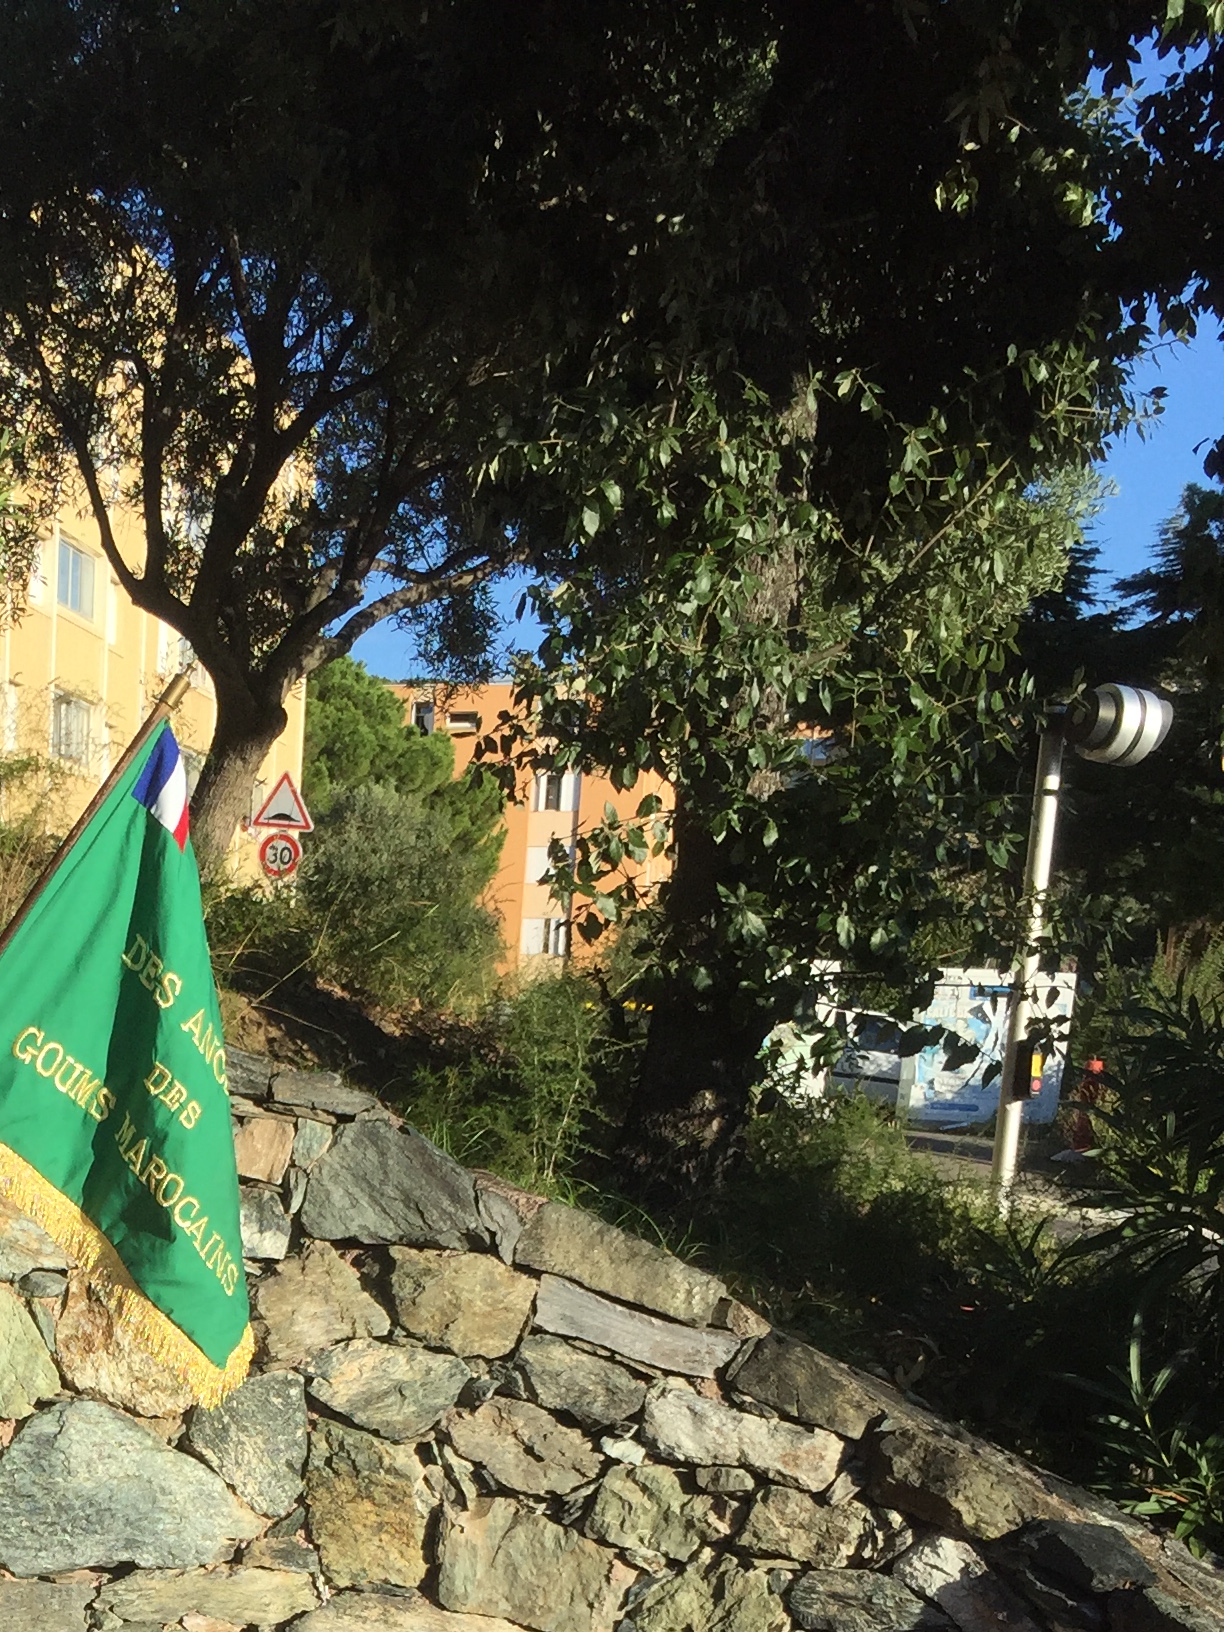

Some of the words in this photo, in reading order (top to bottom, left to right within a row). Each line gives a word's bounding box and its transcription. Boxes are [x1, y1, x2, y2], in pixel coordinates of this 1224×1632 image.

[267, 844, 293, 866] 30
[122, 933, 182, 1010] DES
[143, 1061, 202, 1129] DES
[13, 1026, 116, 1123] GOUMS
[115, 1111, 239, 1297] MAROCAINS
